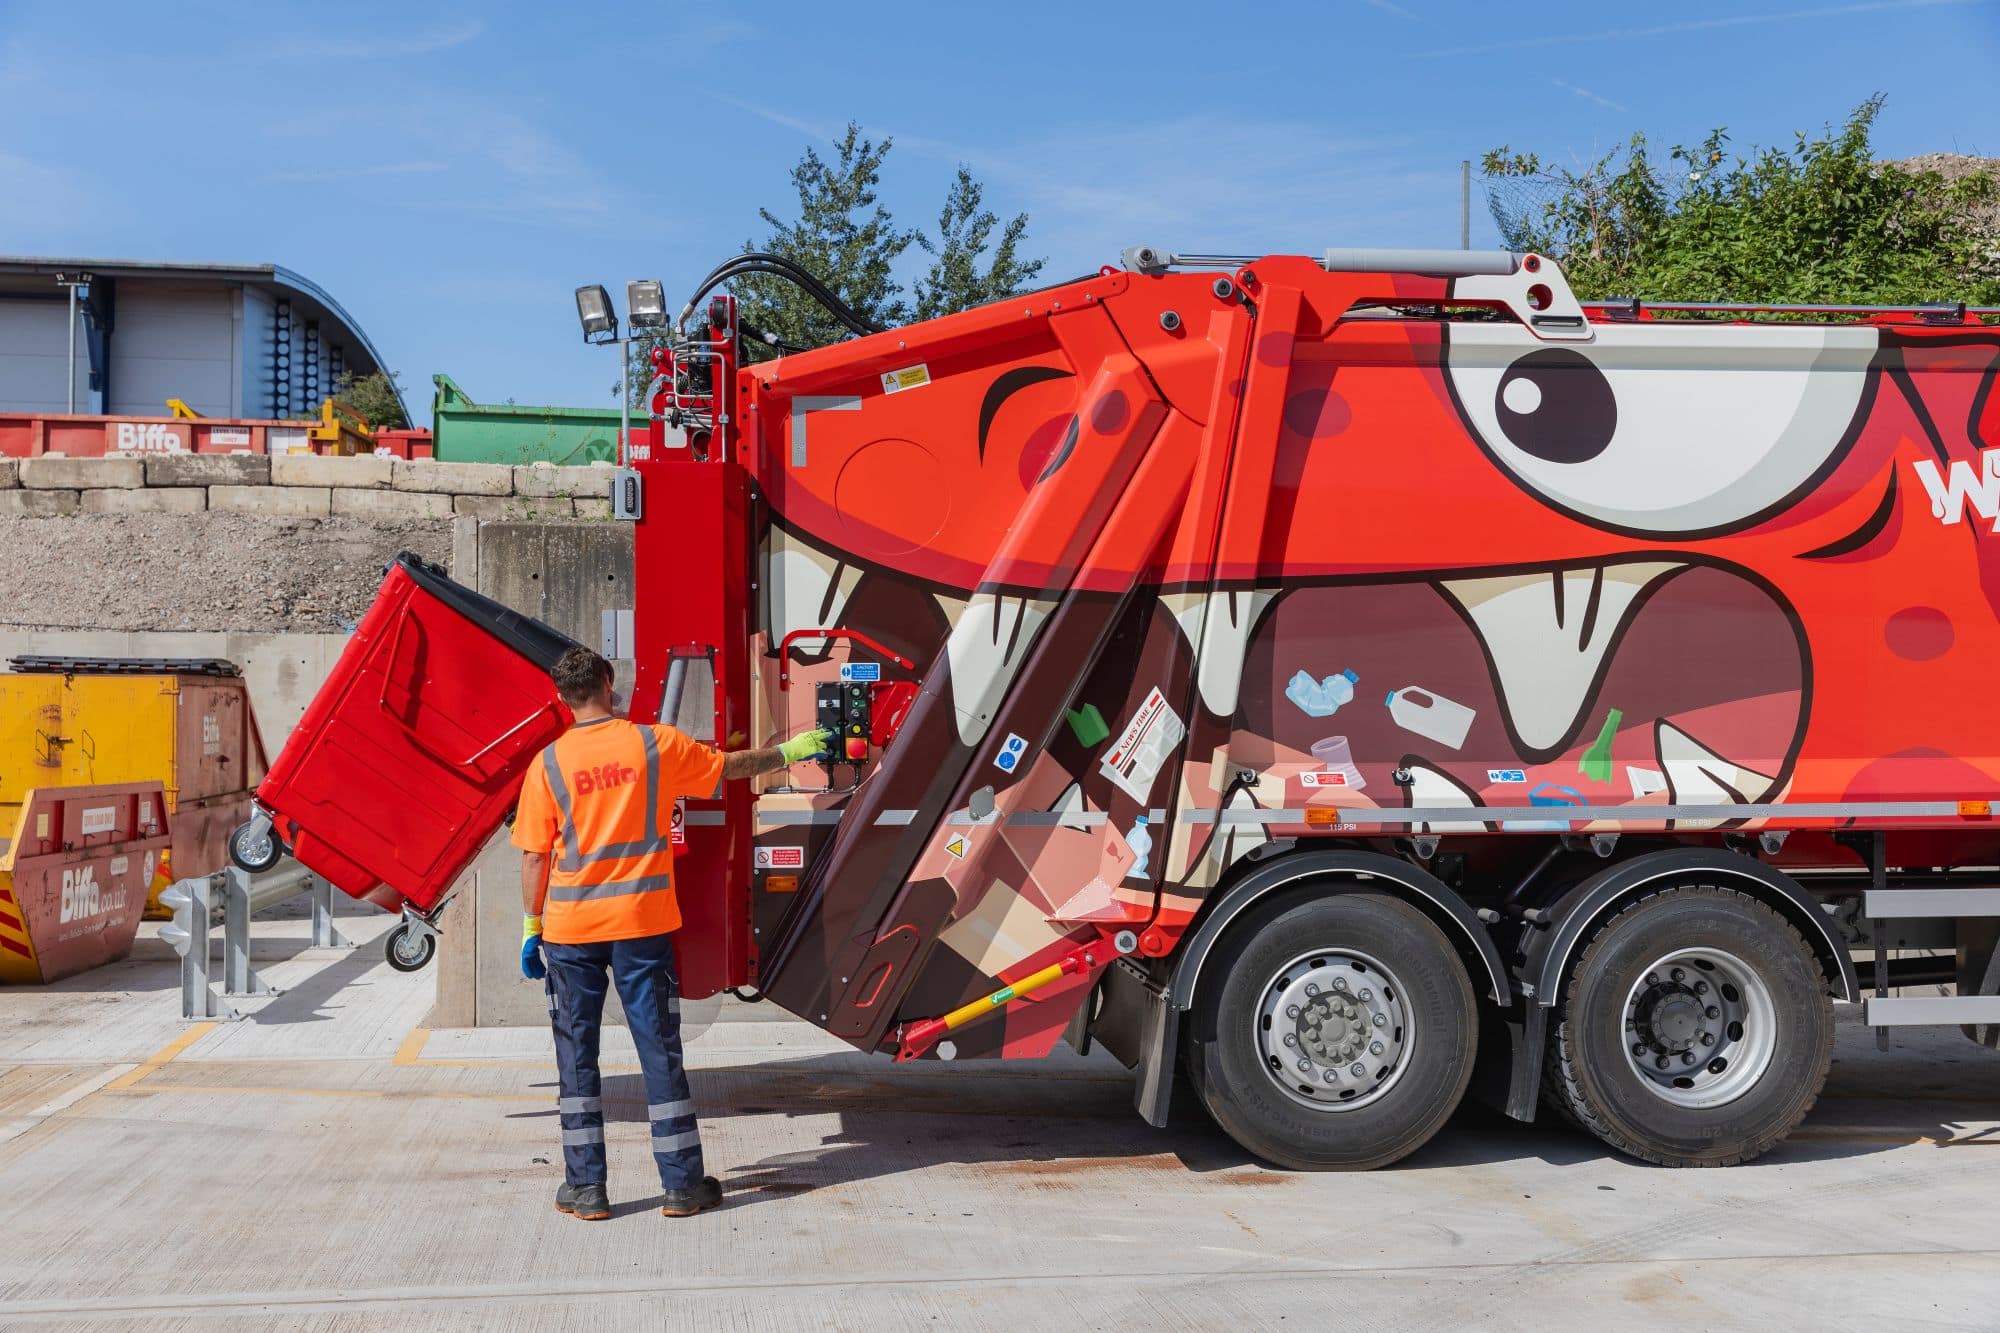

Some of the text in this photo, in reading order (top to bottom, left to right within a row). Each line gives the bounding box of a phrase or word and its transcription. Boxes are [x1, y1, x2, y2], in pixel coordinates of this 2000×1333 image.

[118, 423, 181, 450] Biffa
[1121, 708, 1151, 750] NEWS TIME
[573, 760, 637, 796] Biffa
[1343, 823, 1357, 831] PSI
